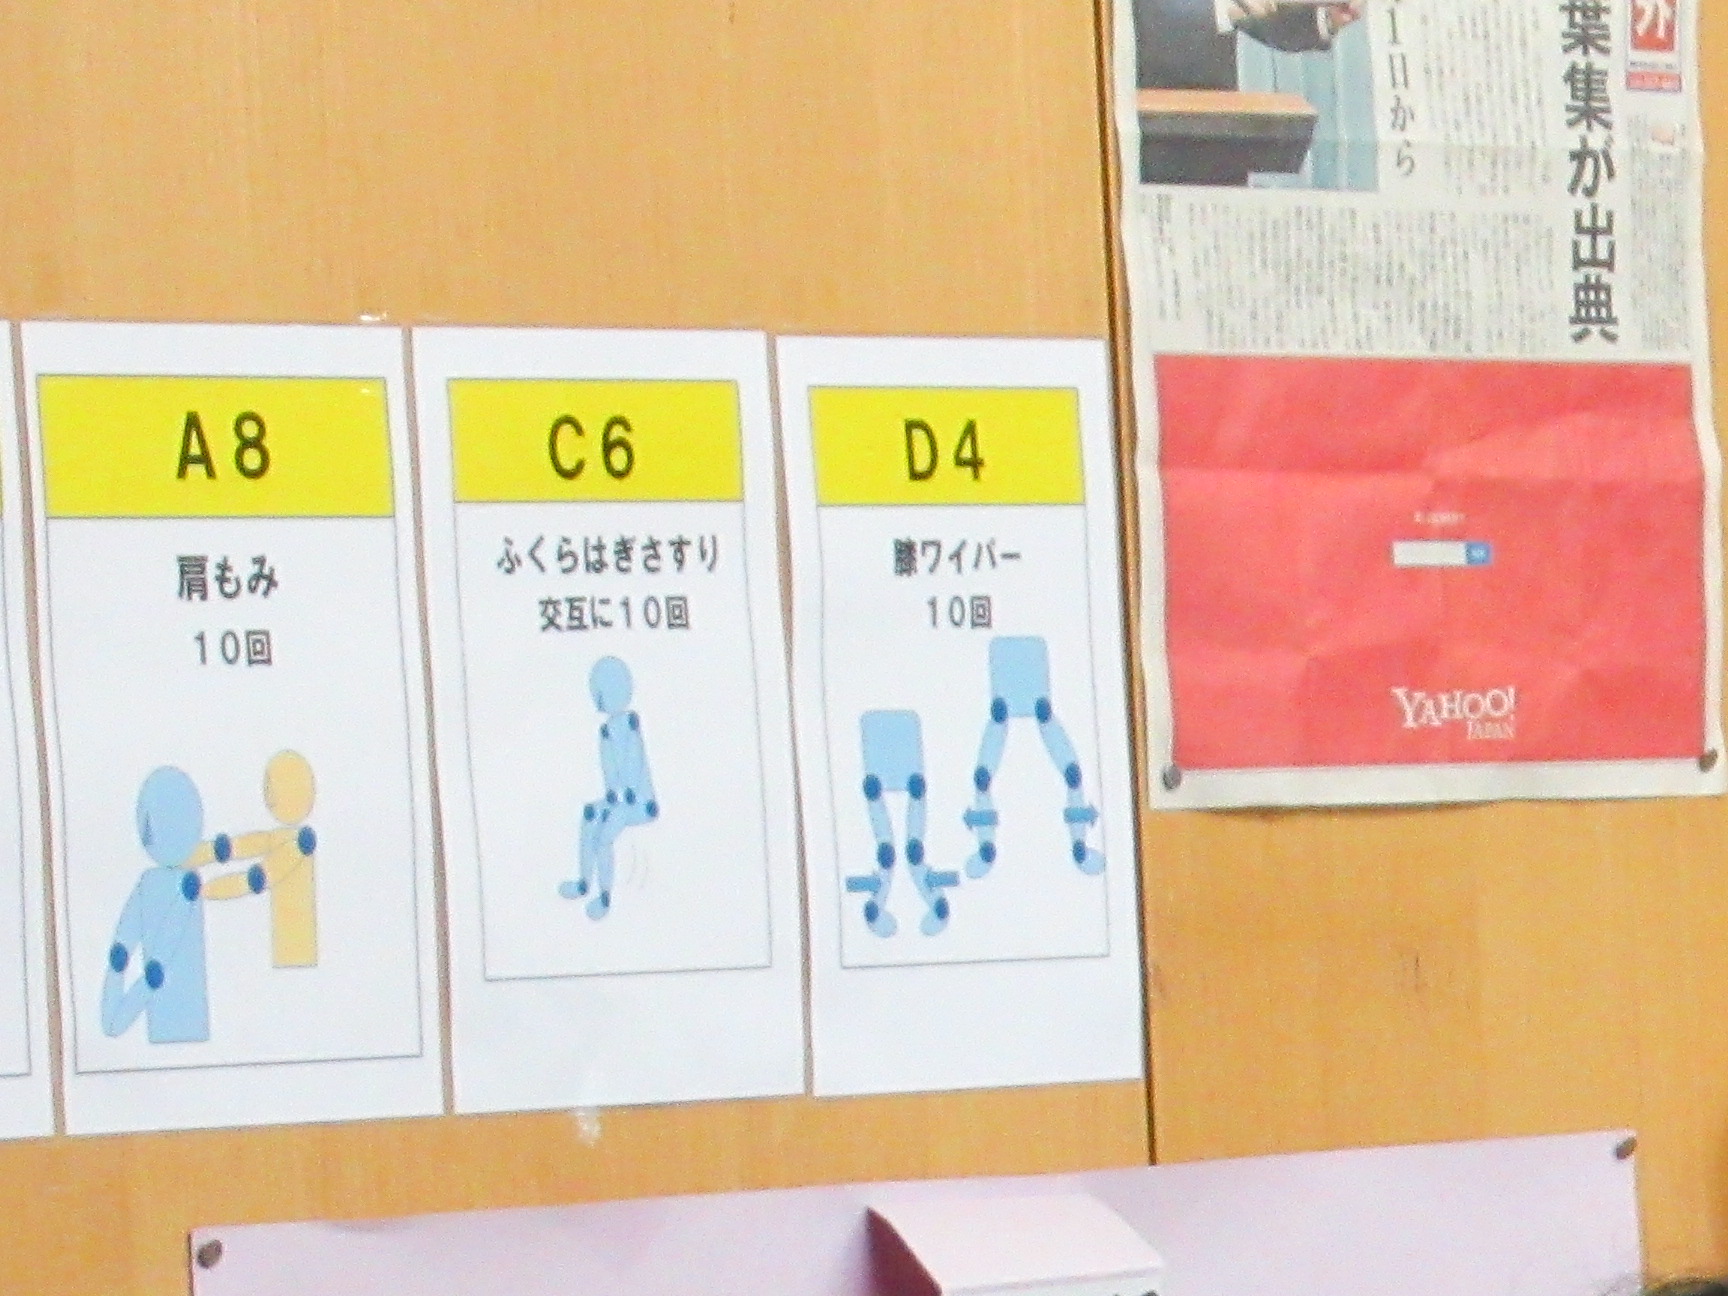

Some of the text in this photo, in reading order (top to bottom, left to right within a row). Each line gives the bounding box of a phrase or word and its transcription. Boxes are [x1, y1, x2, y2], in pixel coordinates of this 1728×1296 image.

[178, 412, 272, 482] A8
[548, 415, 636, 483] C6
[906, 420, 986, 483] D4
[497, 535, 720, 577] ふくらはぎさすり
[176, 555, 280, 604] 肩もみ
[538, 595, 692, 634] 交互に10回
[928, 595, 993, 631] 10回
[194, 630, 274, 669] 10回
[1391, 685, 1516, 729] YAHOO!
